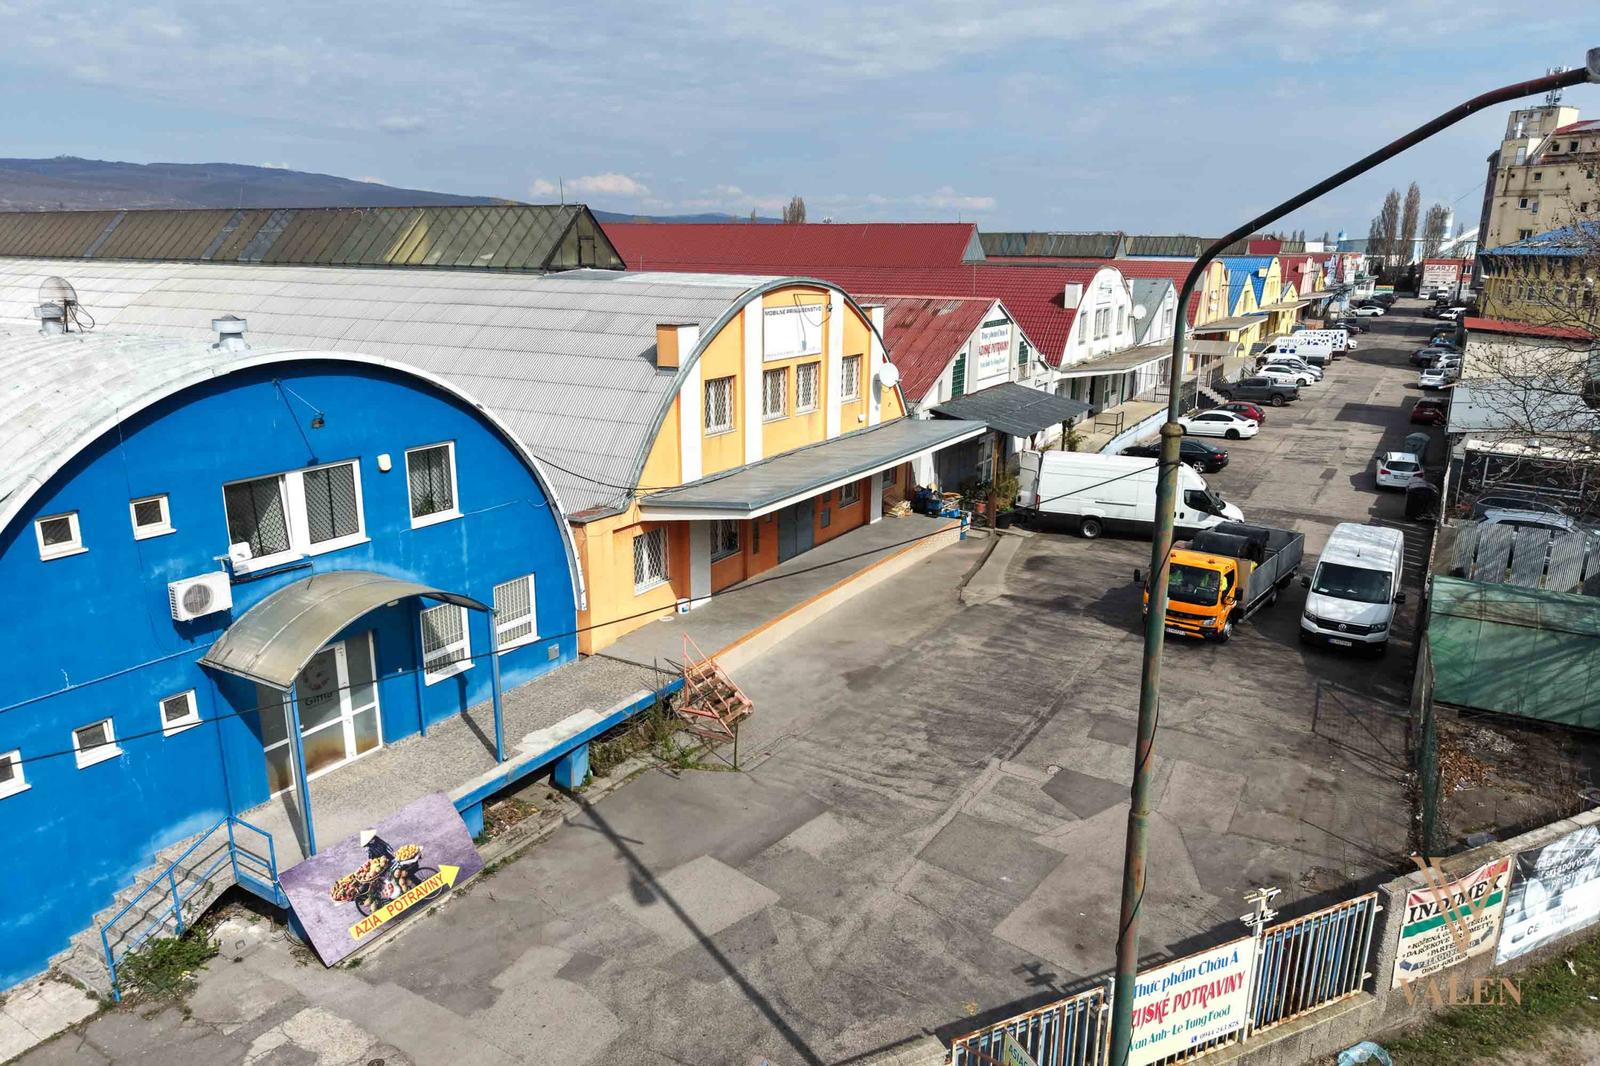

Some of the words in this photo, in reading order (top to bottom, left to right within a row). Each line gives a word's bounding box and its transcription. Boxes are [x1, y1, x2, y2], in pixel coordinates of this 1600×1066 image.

[354, 914, 382, 938] AZIA
[386, 873, 444, 917] POTRAVINY
[1131, 992, 1171, 1030] ZIJSKÉ
[1172, 970, 1246, 1013] POTRAVINY
[1208, 1004, 1231, 1022] Food
